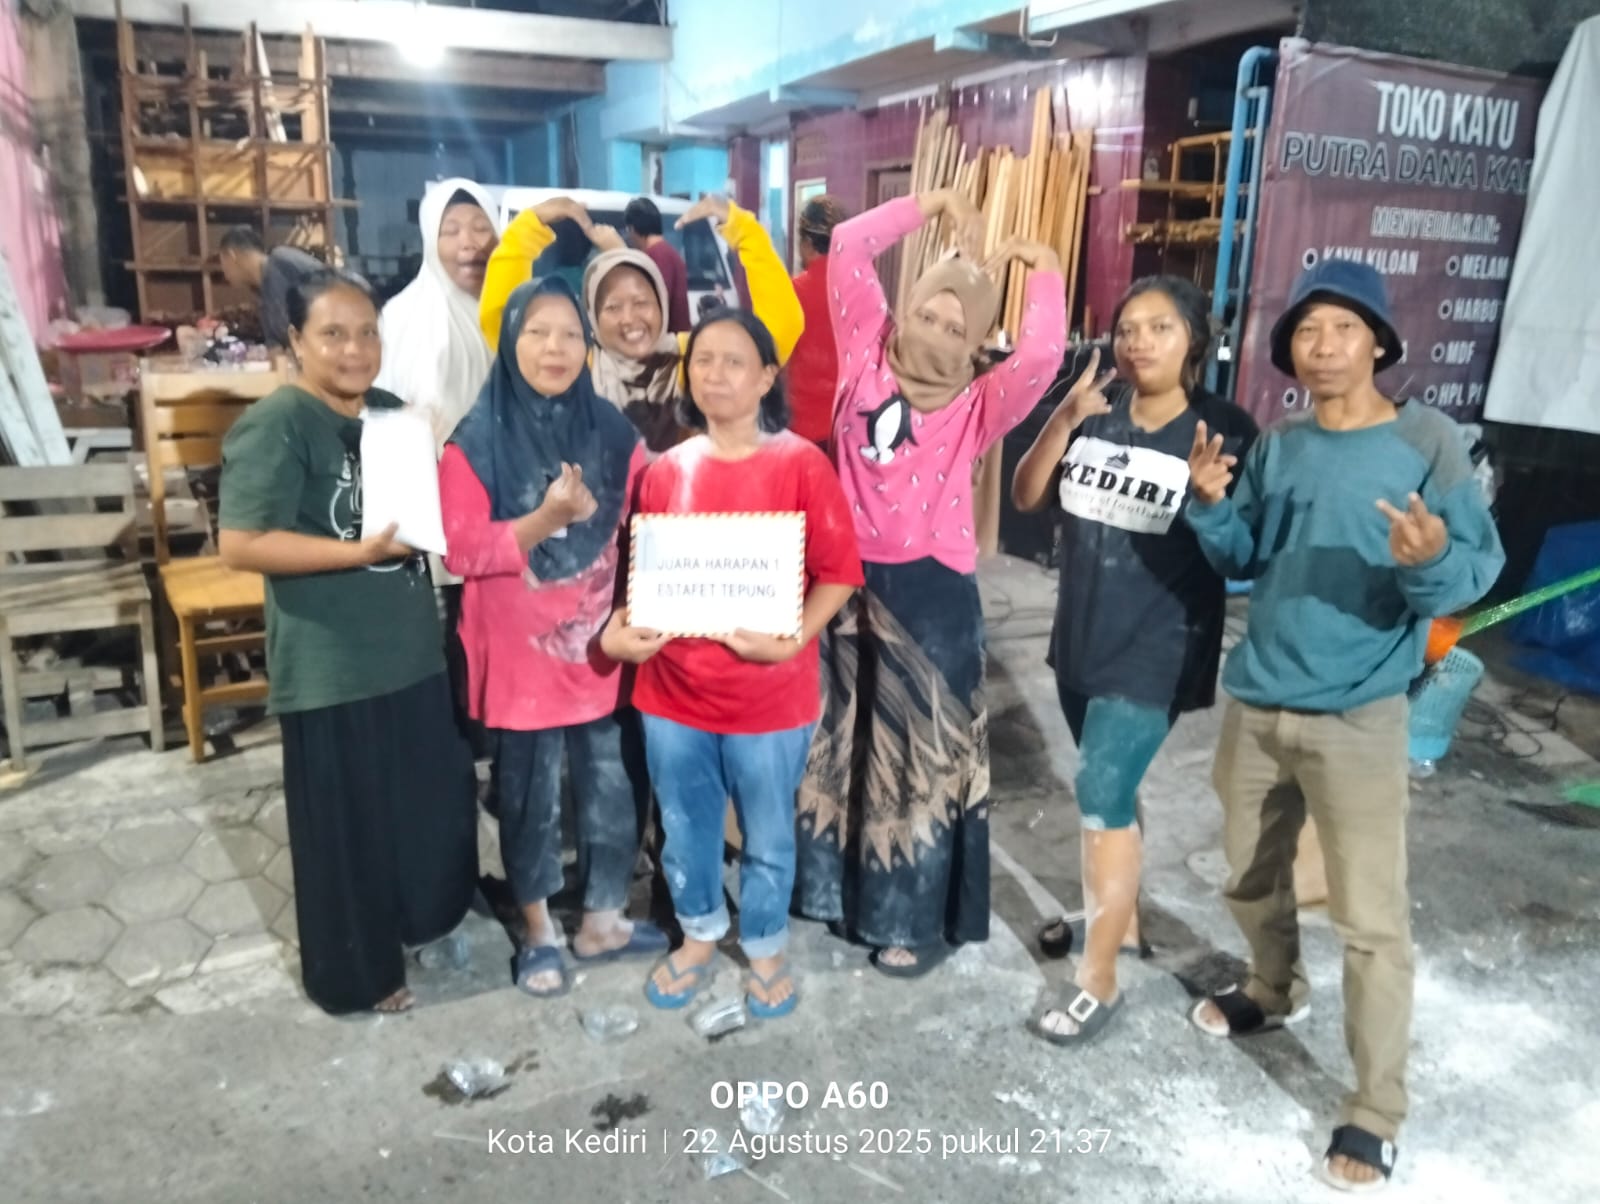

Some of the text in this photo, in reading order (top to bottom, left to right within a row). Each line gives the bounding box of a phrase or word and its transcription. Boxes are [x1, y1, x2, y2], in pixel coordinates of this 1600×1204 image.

[1376, 81, 1519, 150] TOKO KAYU
[1280, 131, 1391, 182] PUTRA
[1395, 144, 1479, 189] DANA
[1366, 247, 1420, 276] KILOAN
[1445, 340, 1477, 365] MDF
[1062, 461, 1177, 507] KEDIRI
[657, 557, 700, 571] JUARA
[705, 557, 769, 571] HARAPAN
[657, 583, 777, 597] ESTAFET TEPUNG
